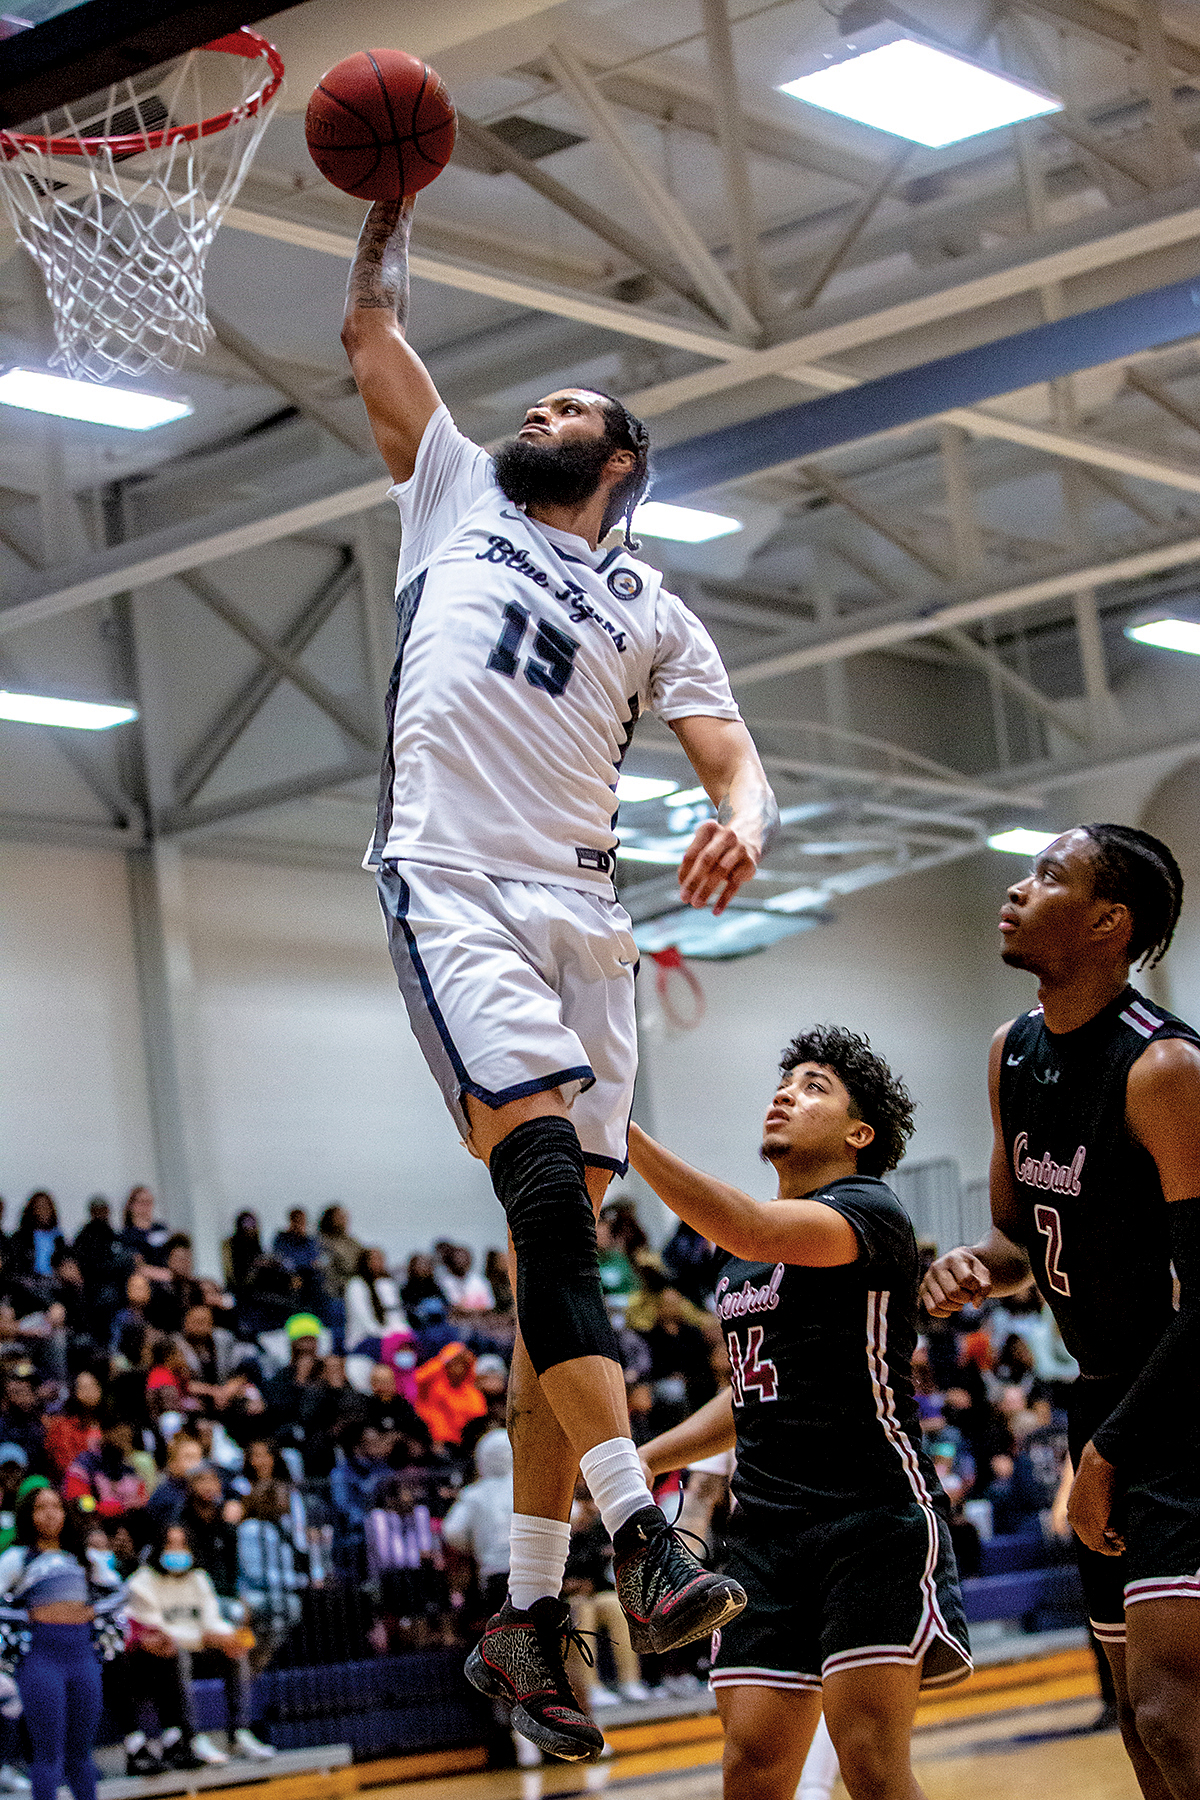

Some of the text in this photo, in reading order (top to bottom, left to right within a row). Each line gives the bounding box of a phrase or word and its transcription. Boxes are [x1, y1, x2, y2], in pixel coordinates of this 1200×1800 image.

[475, 536, 549, 588] Blue
[485, 599, 582, 699] 15
[1013, 1131, 1087, 1197] Central
[1034, 1204, 1071, 1297] 2
[715, 1261, 785, 1322] Central
[727, 1325, 780, 1408] 14
